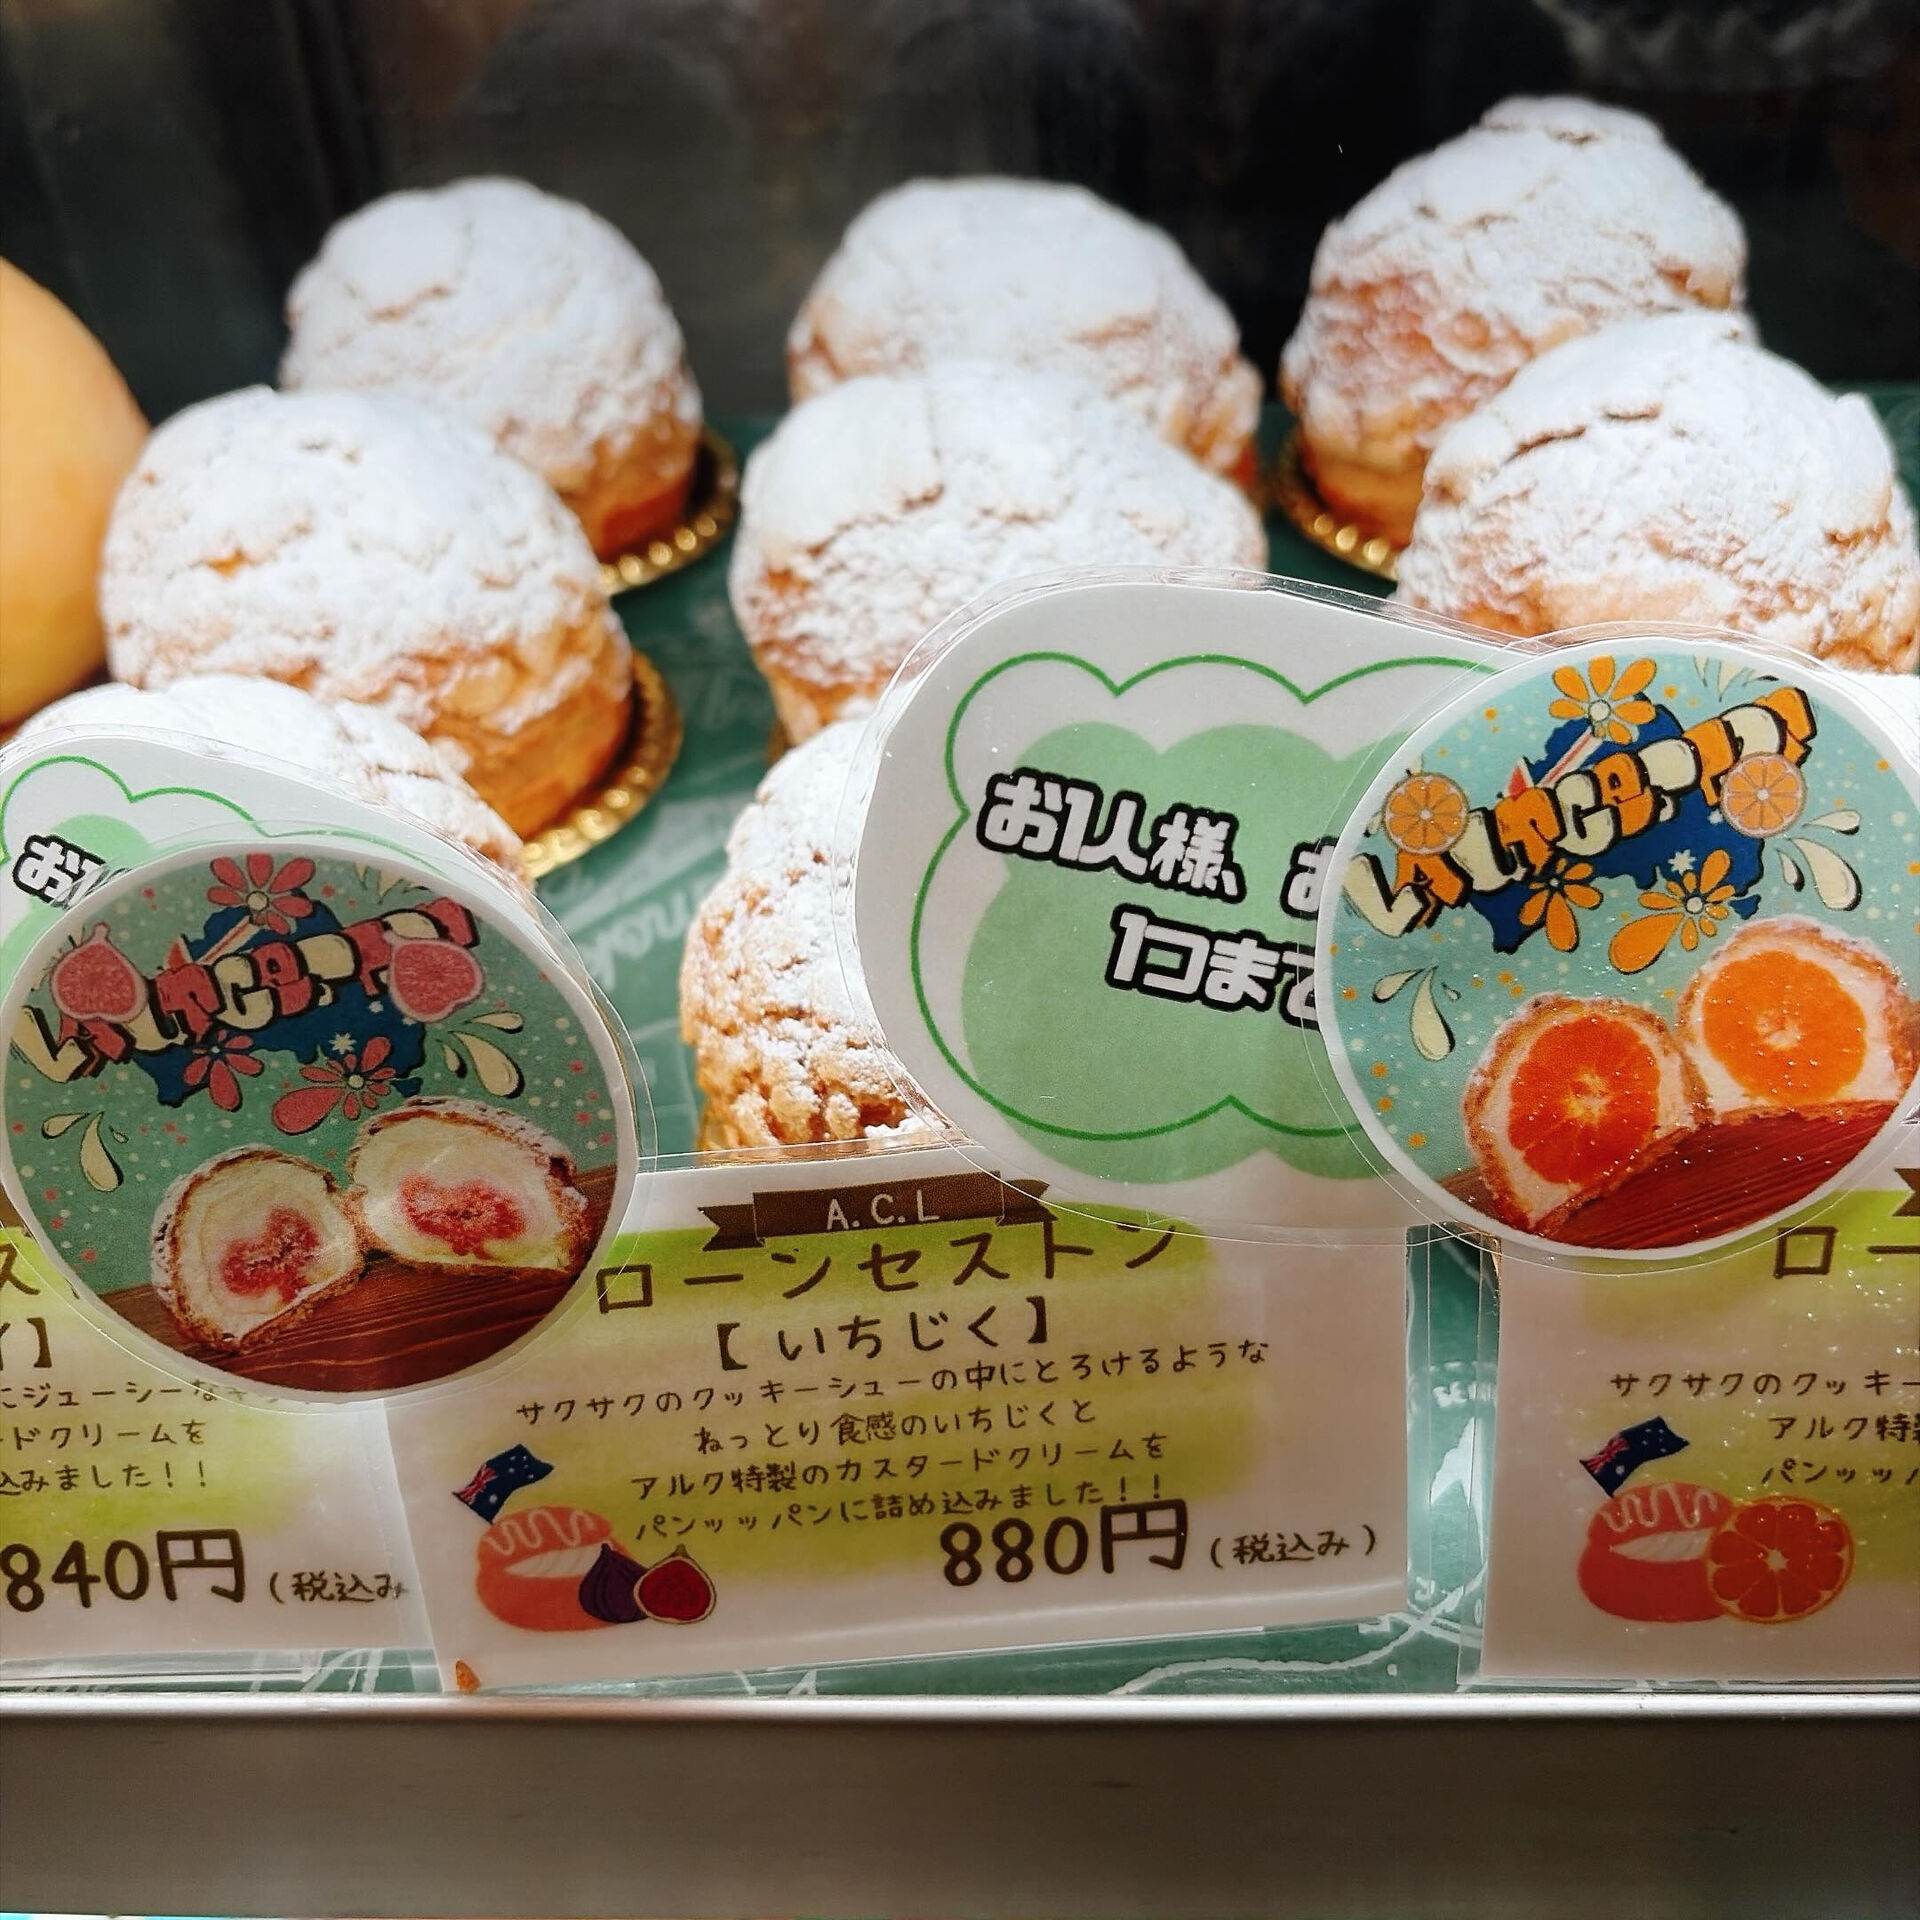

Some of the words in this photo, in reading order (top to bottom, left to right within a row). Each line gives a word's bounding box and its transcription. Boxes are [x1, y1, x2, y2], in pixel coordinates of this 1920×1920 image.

[826, 1189, 940, 1231] A.C.L
[596, 1218, 1177, 1314] ローンセストン
[717, 1296, 1048, 1371] 【いちじく】
[516, 1339, 1269, 1425] サクサクのクッキーシューの中にとろけるような
[0, 1419, 207, 1450] ドクリームを
[694, 1399, 1096, 1455] ねっとり食感のいちじくと
[631, 1433, 1168, 1500] アルク特製のカスタードクリームを
[940, 1498, 1189, 1587] 880円
